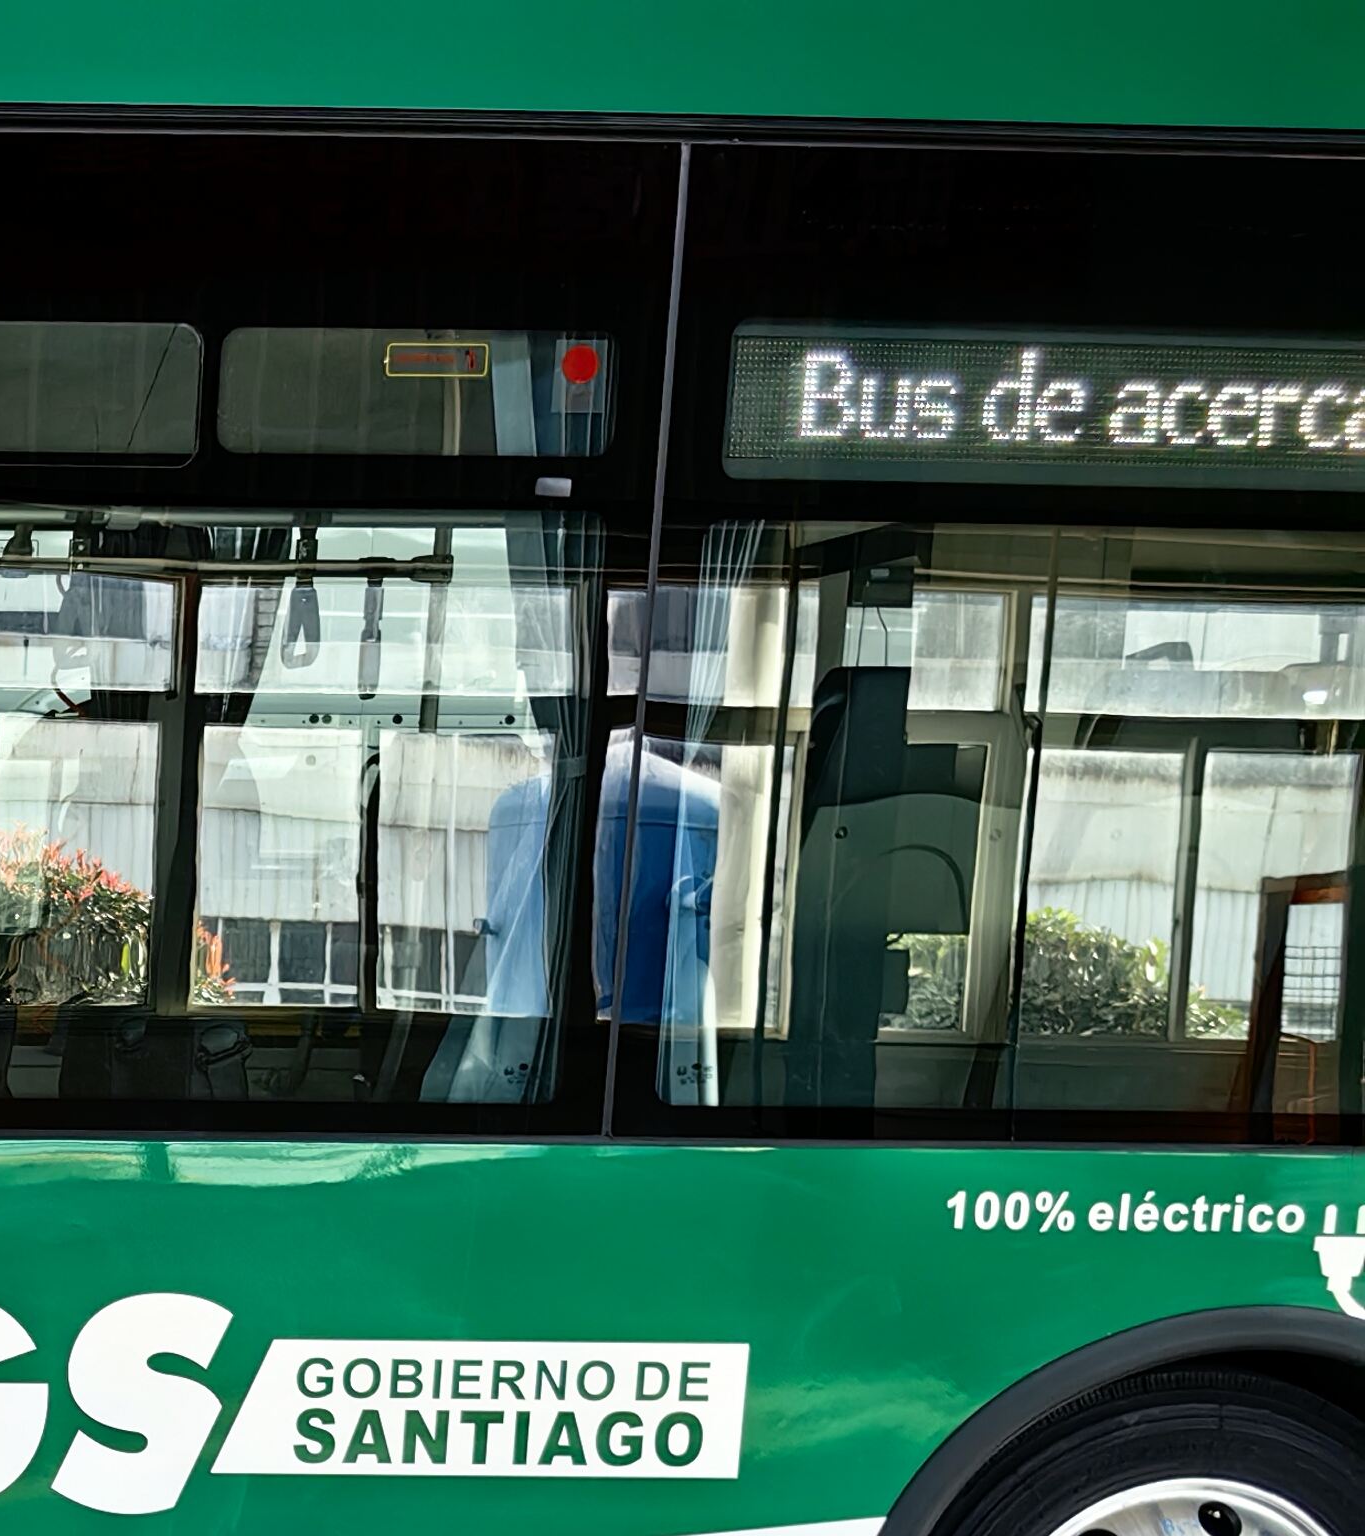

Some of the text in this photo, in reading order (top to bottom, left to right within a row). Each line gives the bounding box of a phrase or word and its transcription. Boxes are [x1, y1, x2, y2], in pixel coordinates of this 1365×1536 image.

[800, 352, 959, 438] Bus
[982, 350, 1085, 442] de
[947, 1190, 1306, 1234] 100% eléctrico
[296, 1357, 711, 1402] GOBIERNO DE
[293, 1407, 704, 1467] SANTIAGO
